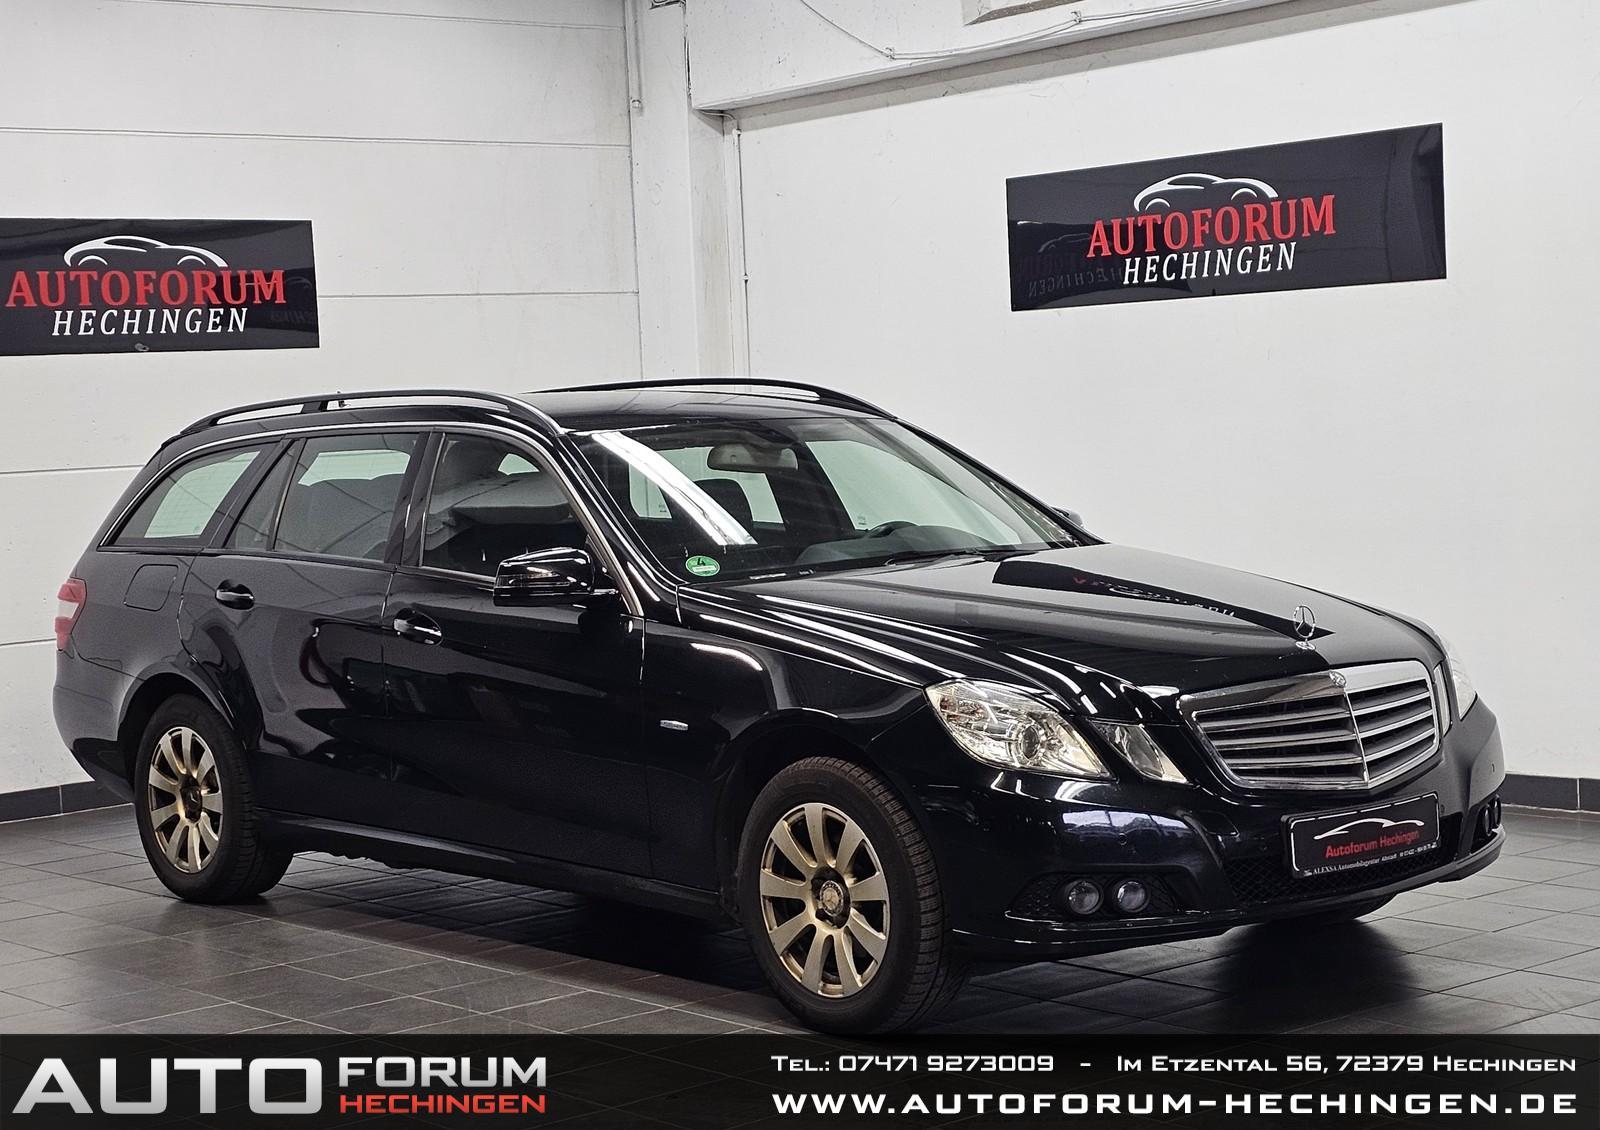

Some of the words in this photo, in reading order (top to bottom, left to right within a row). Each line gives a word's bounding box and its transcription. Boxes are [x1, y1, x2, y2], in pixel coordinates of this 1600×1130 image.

[1086, 194, 1337, 259] AUTOFORUM
[1122, 242, 1297, 285] HECHINGEN
[5, 269, 286, 308] AUTOFORUM
[51, 307, 248, 336] HECHINGEN
[1325, 840, 1378, 859] Autoforum
[1379, 830, 1420, 848] Hechingen
